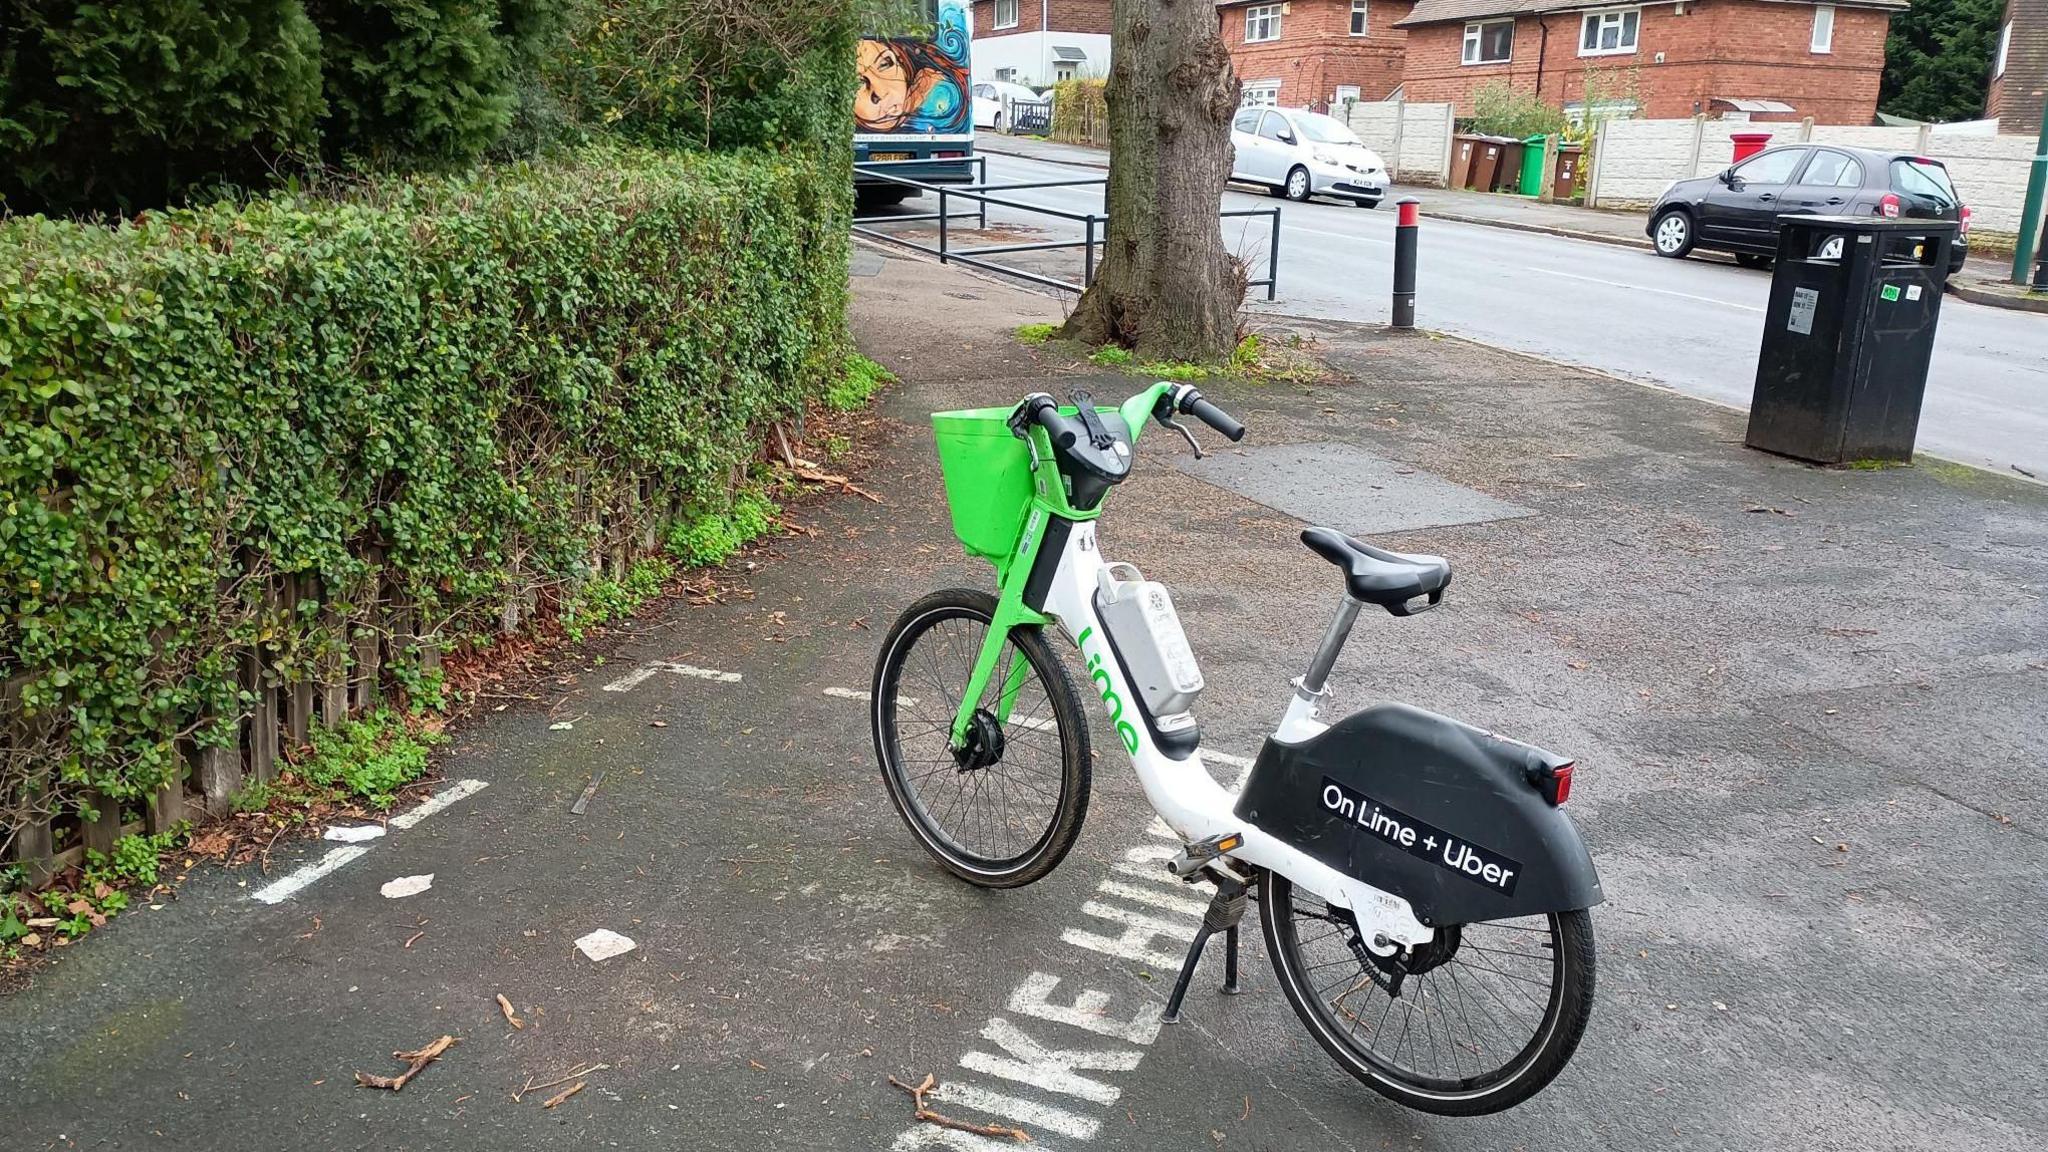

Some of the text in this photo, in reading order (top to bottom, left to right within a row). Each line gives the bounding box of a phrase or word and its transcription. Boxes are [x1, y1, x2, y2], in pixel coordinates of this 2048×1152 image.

[1078, 626, 1138, 756] Lime
[1323, 784, 1355, 818] On
[1357, 800, 1417, 847] Lime
[1442, 838, 1514, 888] Uber
